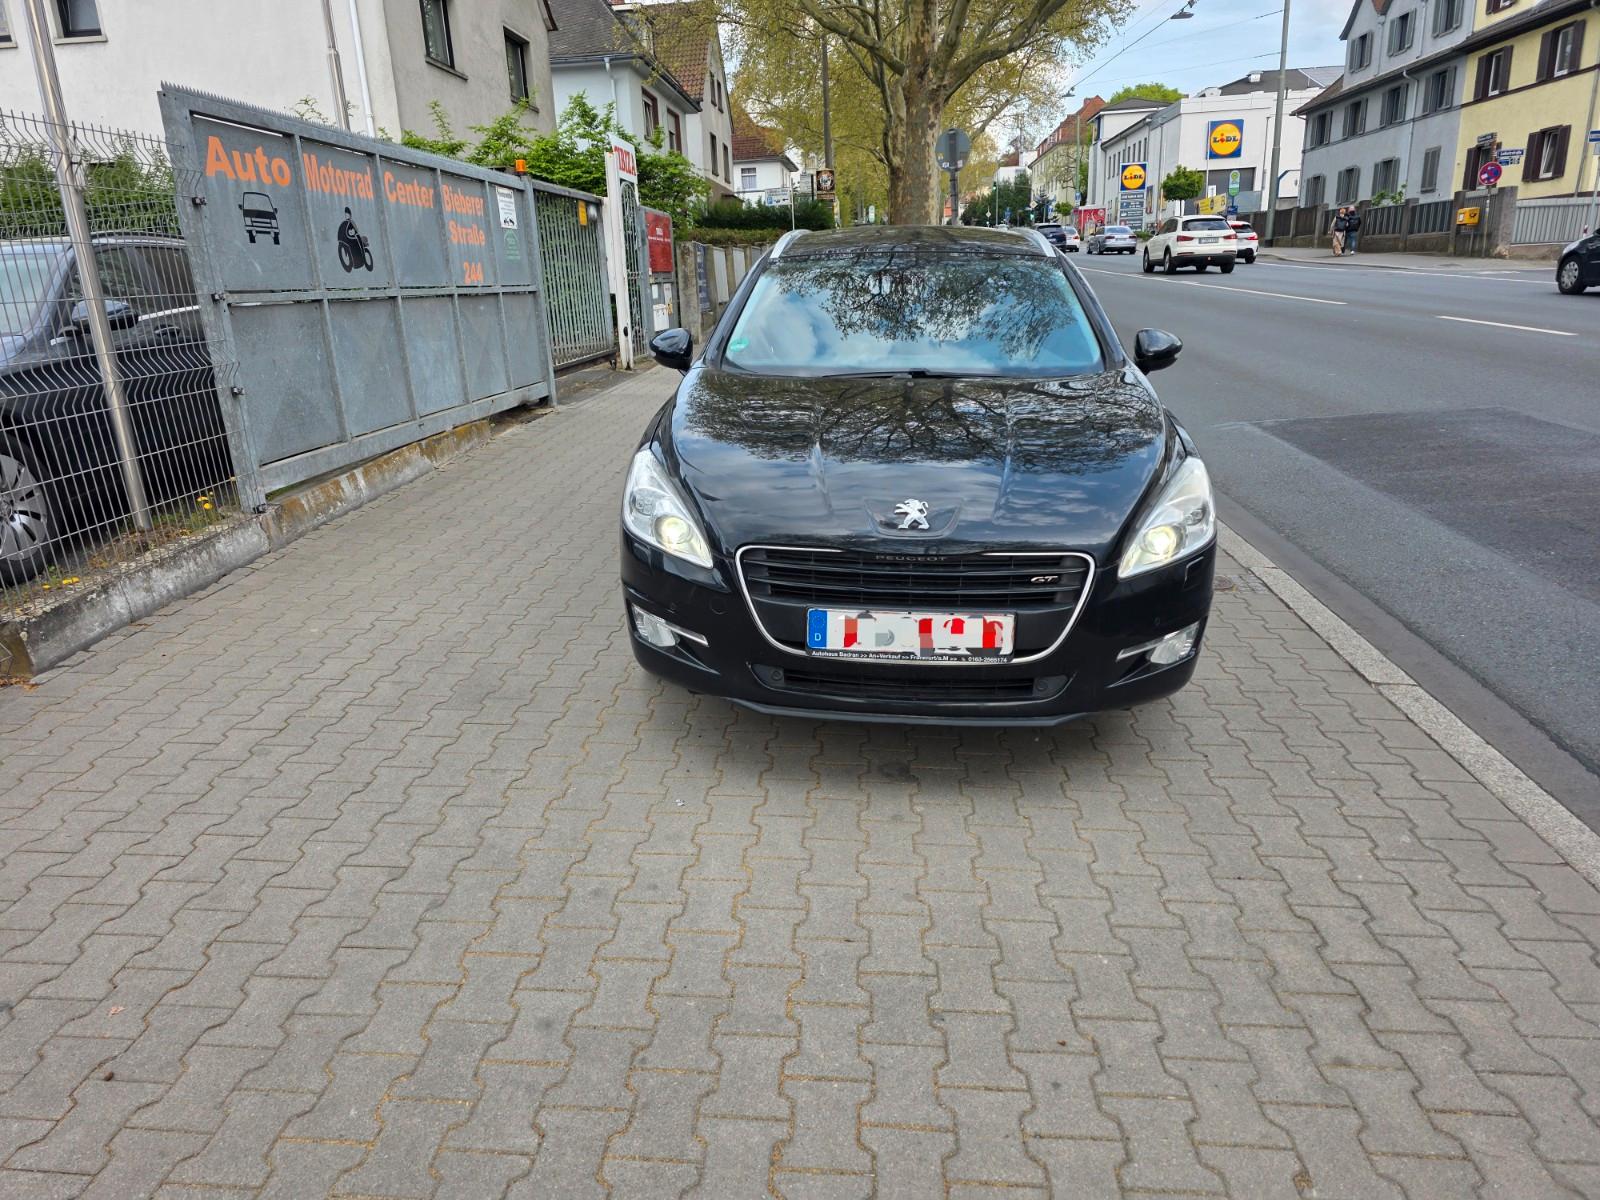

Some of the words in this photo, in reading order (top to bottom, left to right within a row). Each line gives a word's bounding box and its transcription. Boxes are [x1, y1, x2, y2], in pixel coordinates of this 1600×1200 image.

[206, 135, 291, 187] Auto
[303, 153, 374, 200] Motorrad
[384, 171, 434, 208] Center
[442, 184, 484, 216] Bieberer
[449, 220, 485, 246] Straße
[463, 261, 484, 284] 244
[1031, 575, 1058, 584] GT
[814, 633, 822, 642] D
